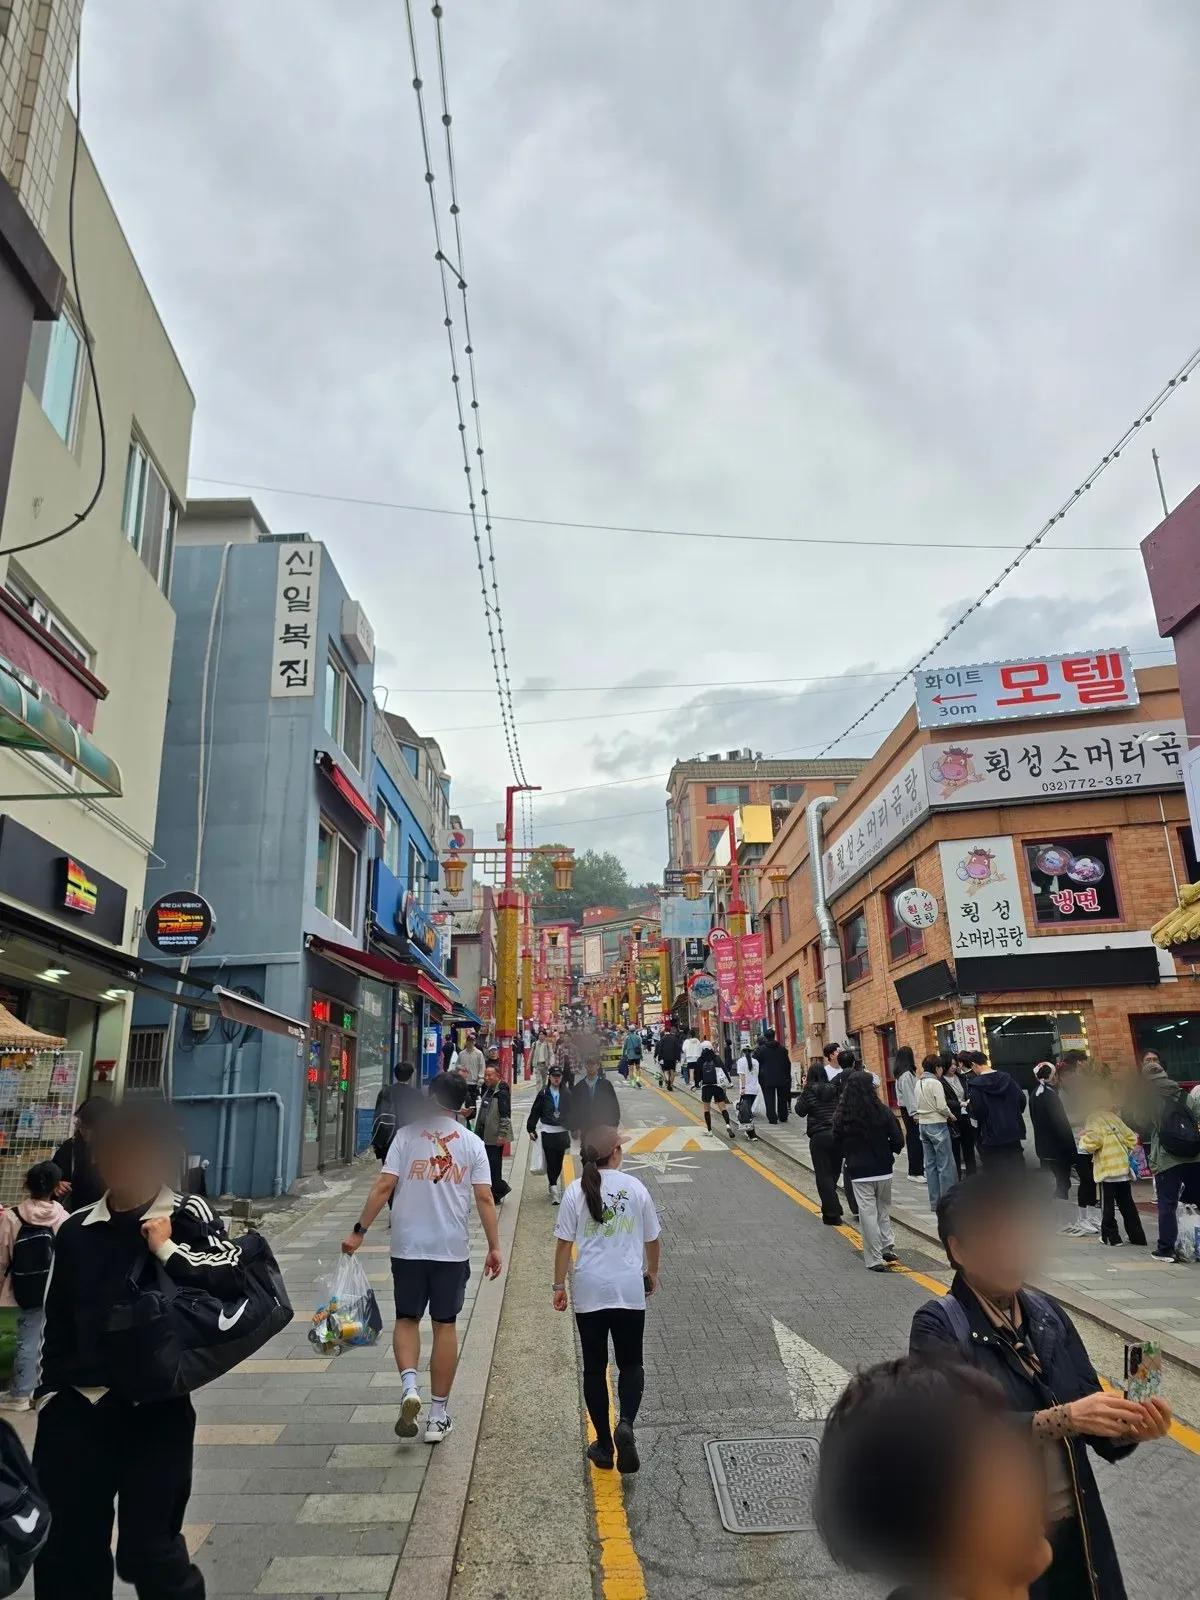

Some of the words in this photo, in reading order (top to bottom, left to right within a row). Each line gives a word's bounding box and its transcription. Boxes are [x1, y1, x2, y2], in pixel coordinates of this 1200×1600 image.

[278, 550, 313, 688] 신일복집
[925, 670, 983, 689] 화이트
[996, 653, 1128, 706] 모텔
[939, 704, 977, 717] 30m
[1041, 773, 1142, 792] 032)772-3527
[836, 768, 918, 871] 횡성소머리곰탕
[1050, 888, 1101, 914] 냉면
[955, 926, 1024, 949] 소머리곰탕
[965, 1024, 978, 1048] 한우
